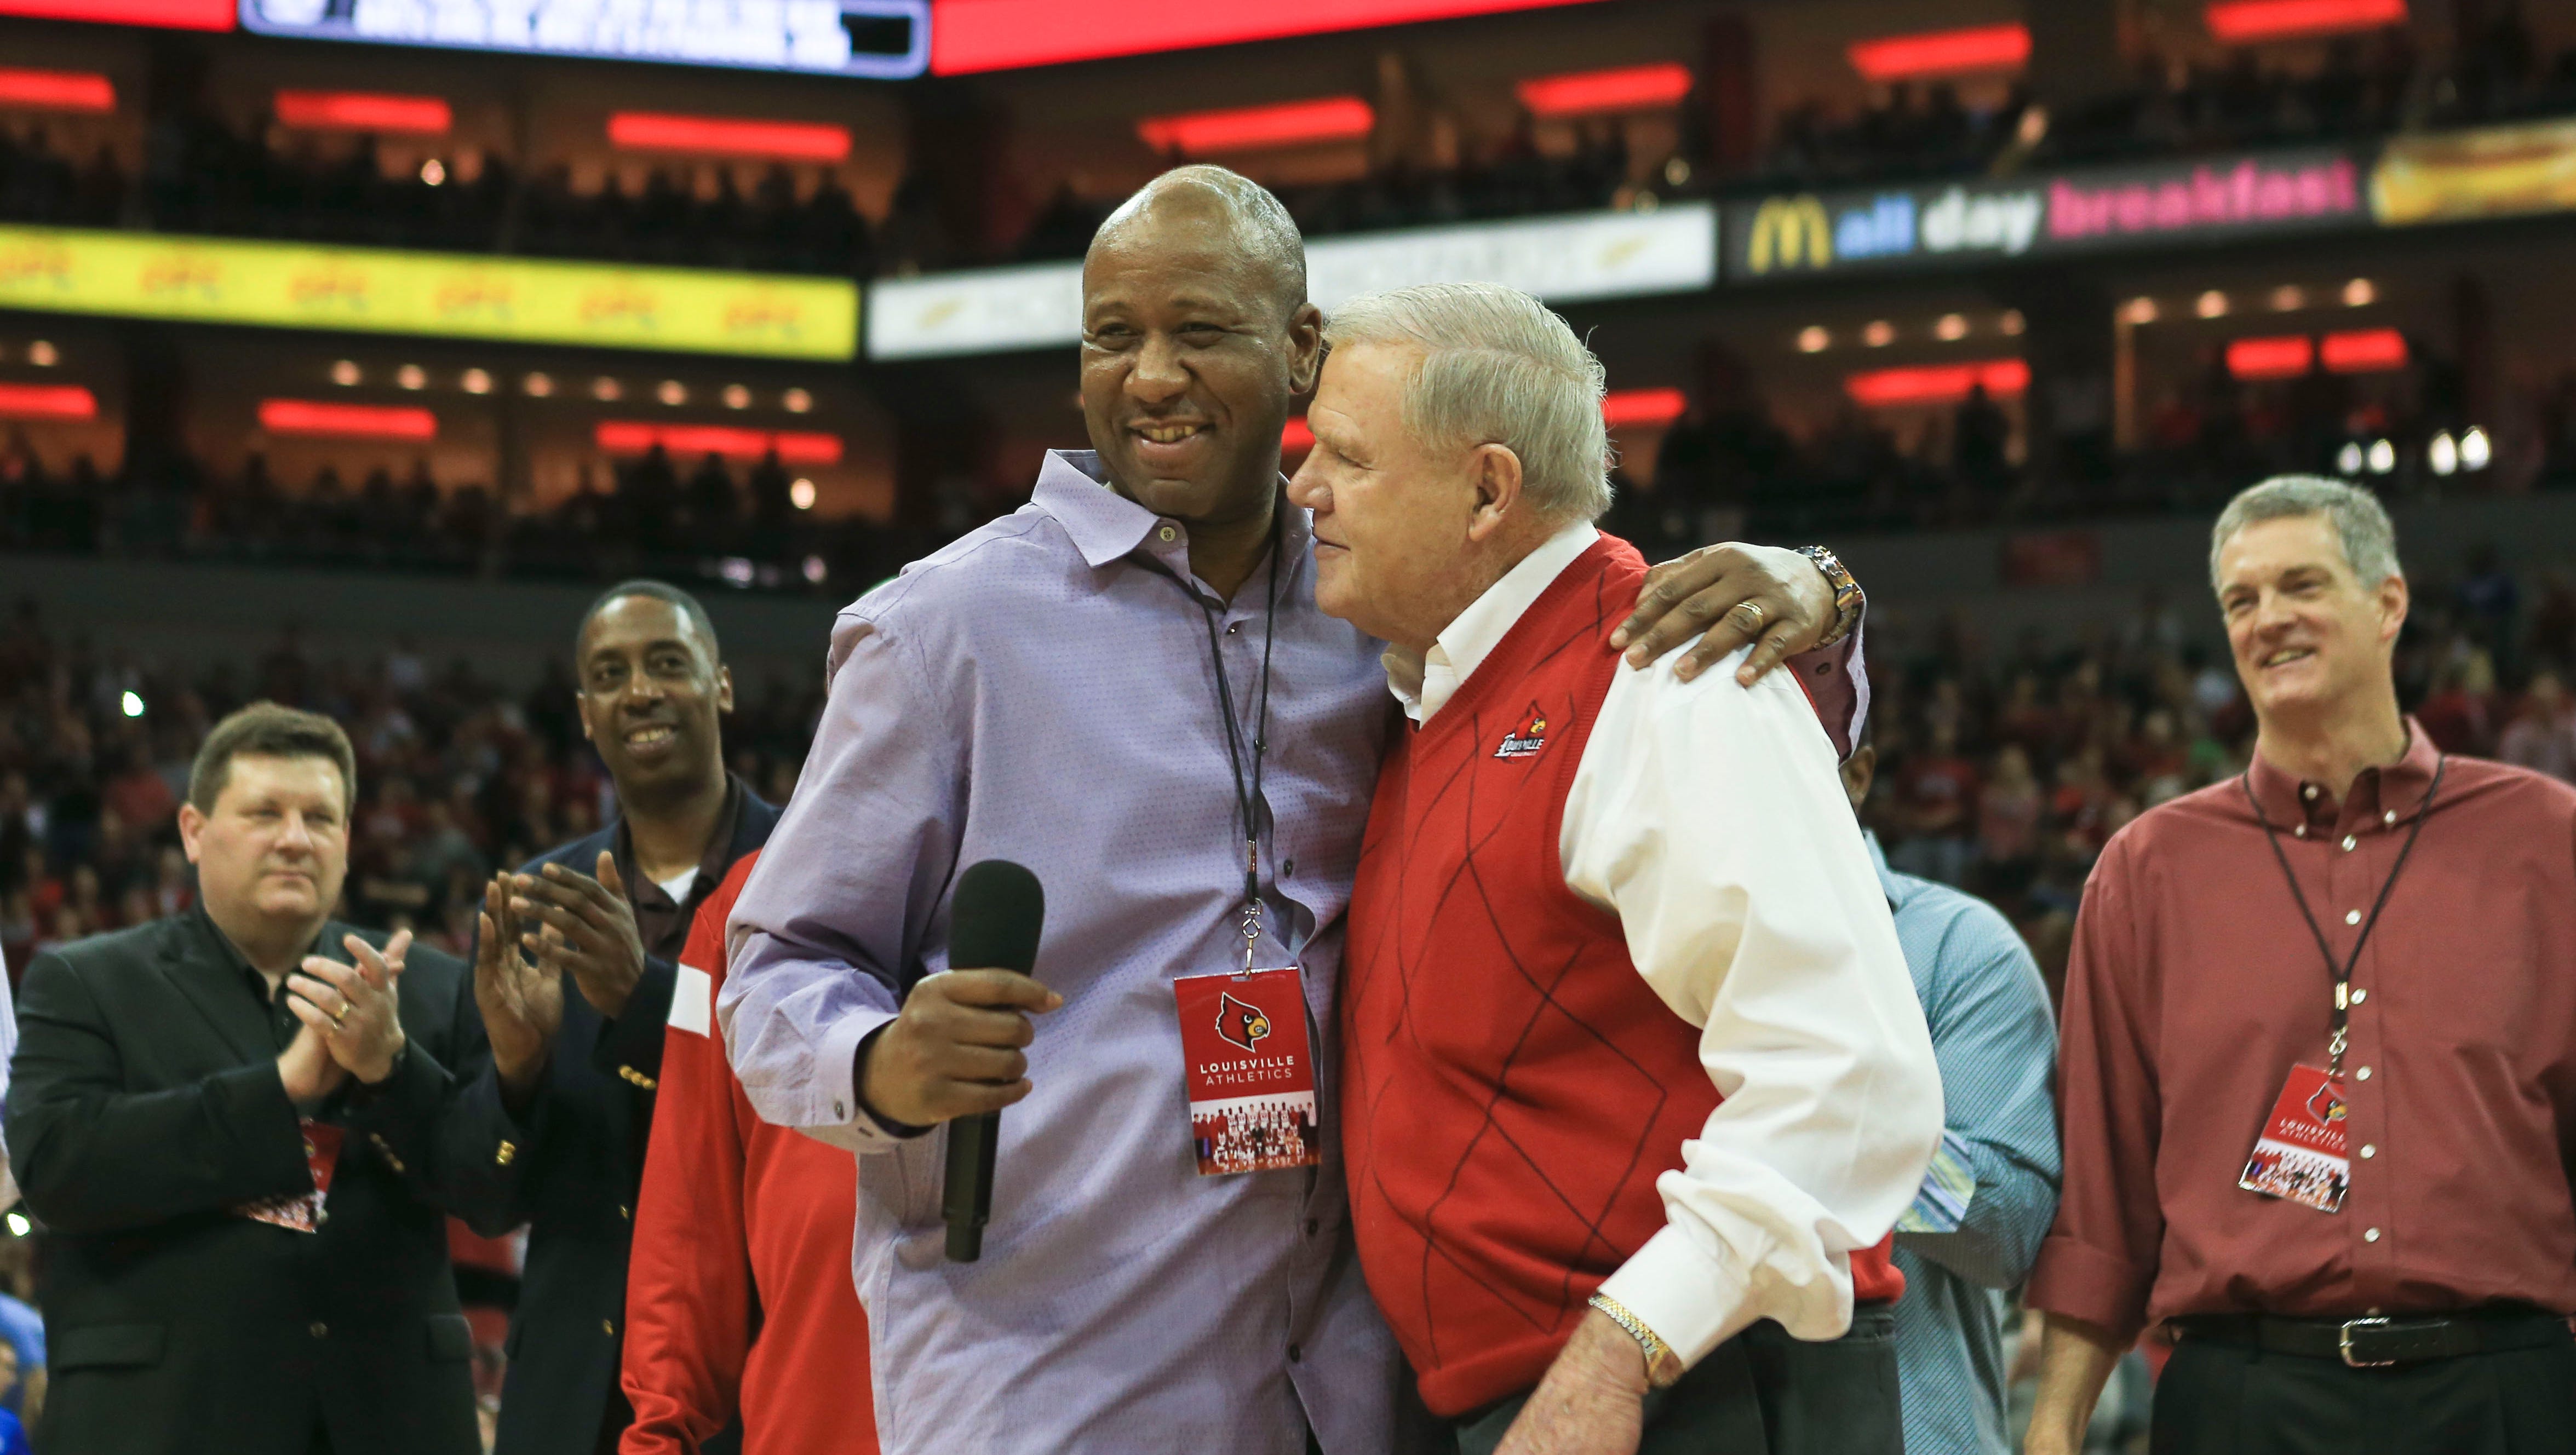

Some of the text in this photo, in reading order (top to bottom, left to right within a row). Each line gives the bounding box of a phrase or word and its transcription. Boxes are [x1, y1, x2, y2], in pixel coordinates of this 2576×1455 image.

[1835, 195, 1914, 260] all
[1923, 188, 2040, 255] day
[2049, 158, 2356, 239] breakfast
[1200, 1056, 1294, 1074] LOUISVILLE
[1206, 1068, 1292, 1086] ATHLETICS
[2279, 1117, 2344, 1142] LOUISVILL
